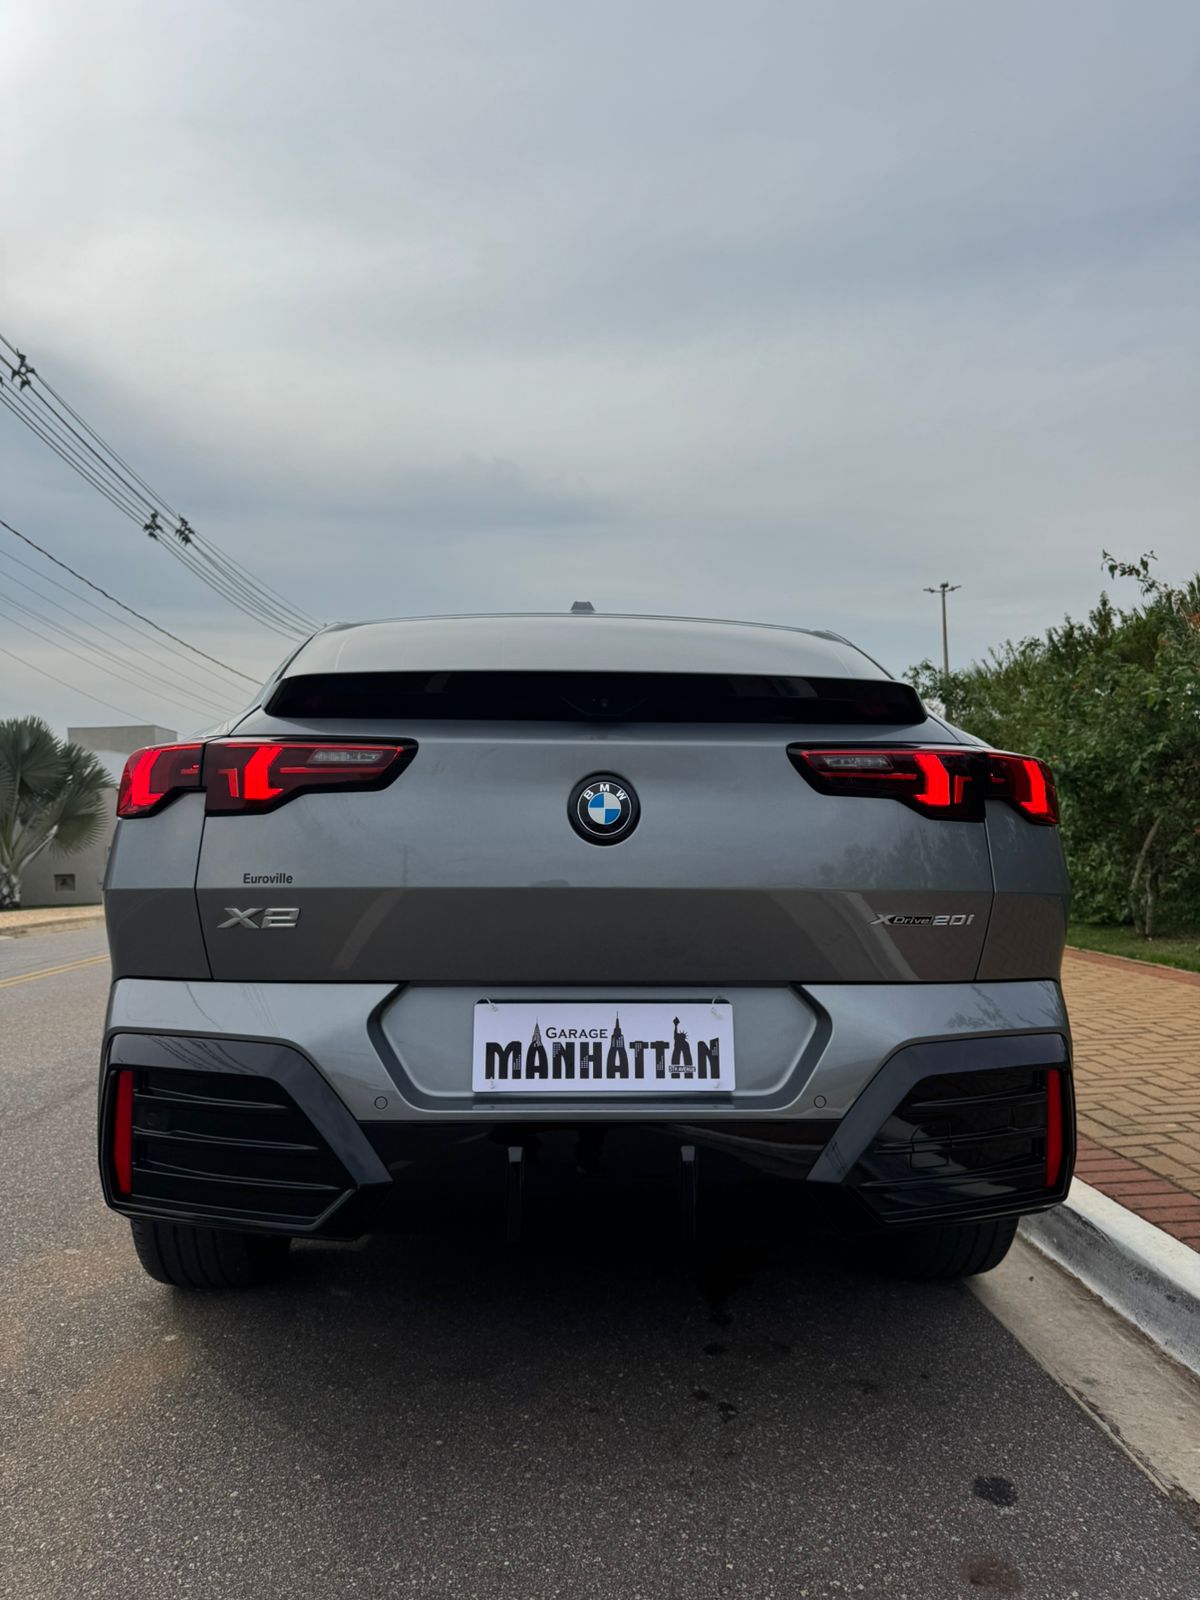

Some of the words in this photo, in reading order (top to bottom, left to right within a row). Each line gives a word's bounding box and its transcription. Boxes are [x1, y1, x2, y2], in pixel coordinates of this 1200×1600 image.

[583, 784, 627, 801] BMW
[243, 873, 294, 884] Euroville
[217, 907, 300, 928] X2
[485, 1036, 720, 1079] MANHATTAN
